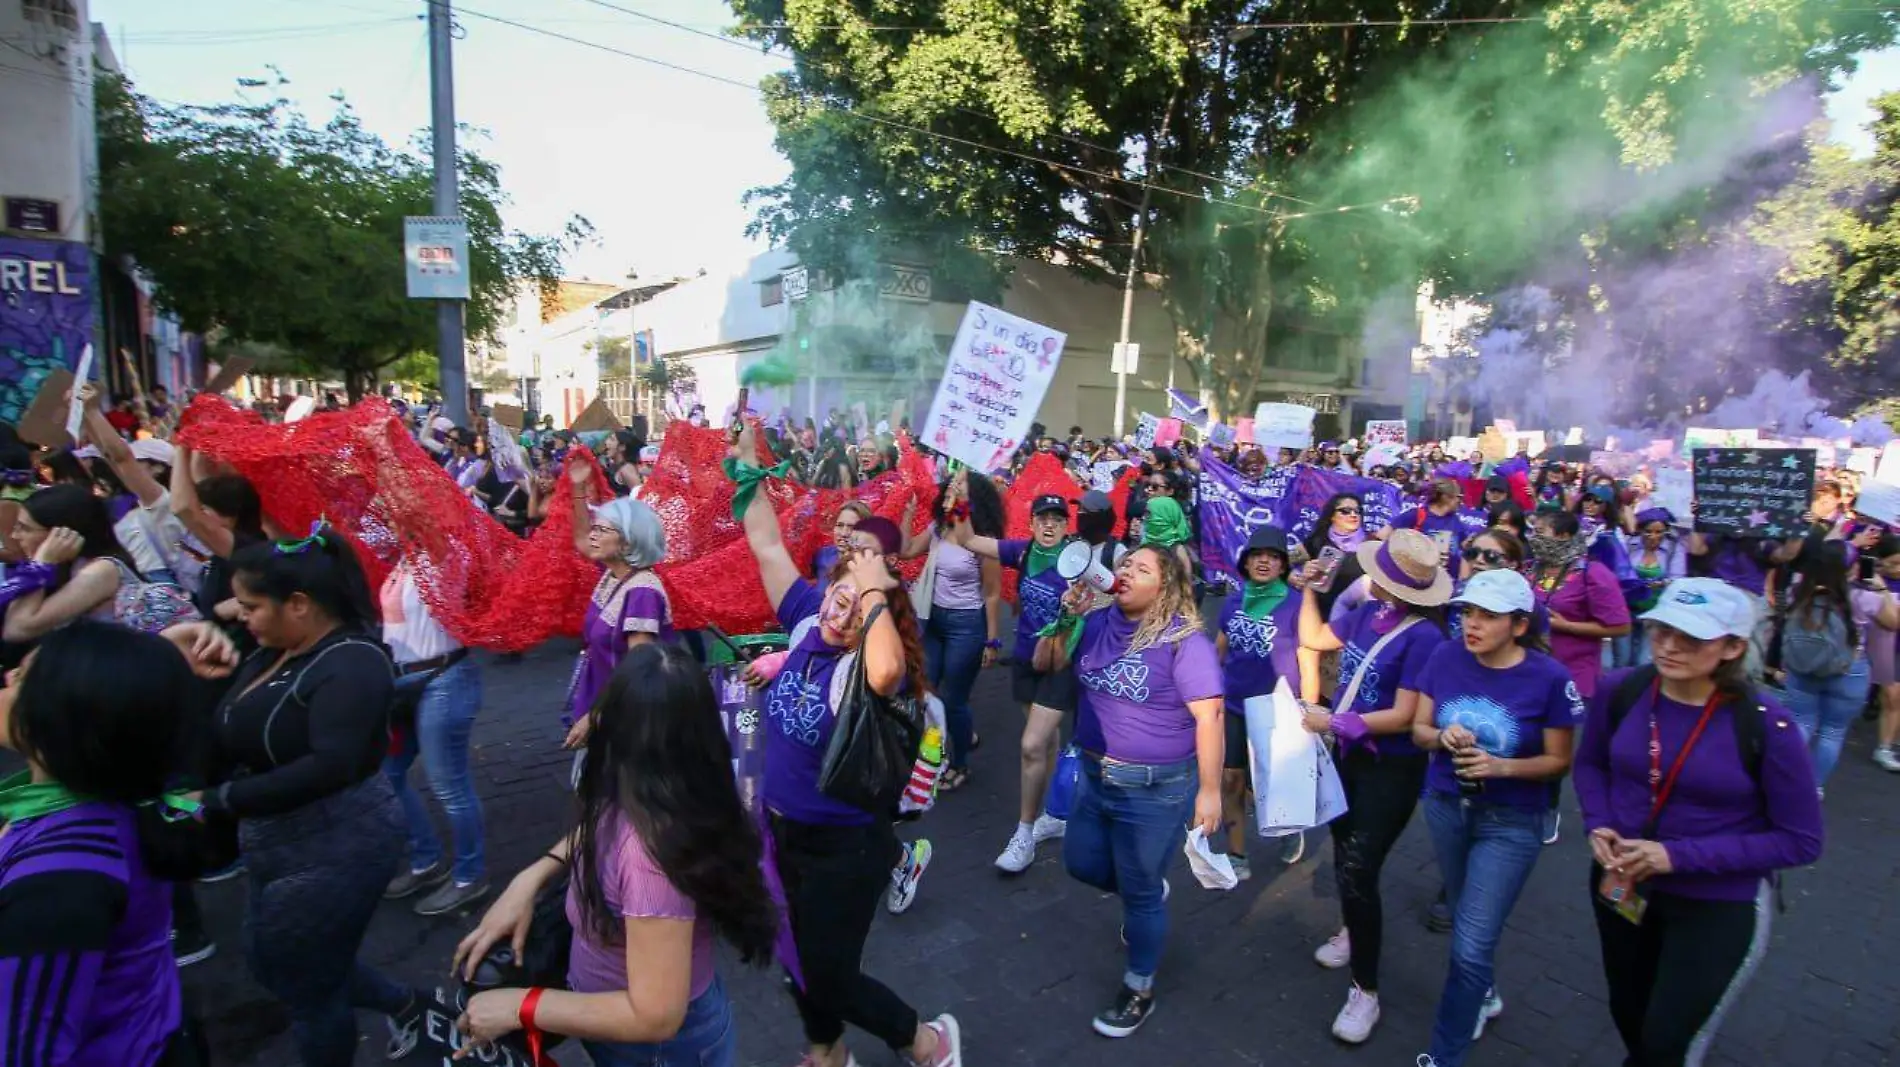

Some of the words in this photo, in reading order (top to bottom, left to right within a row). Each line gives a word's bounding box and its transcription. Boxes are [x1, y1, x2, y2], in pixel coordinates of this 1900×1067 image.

[0, 259, 81, 295] REL
[994, 326, 1010, 340] un
[1710, 466, 1761, 478] mañana
